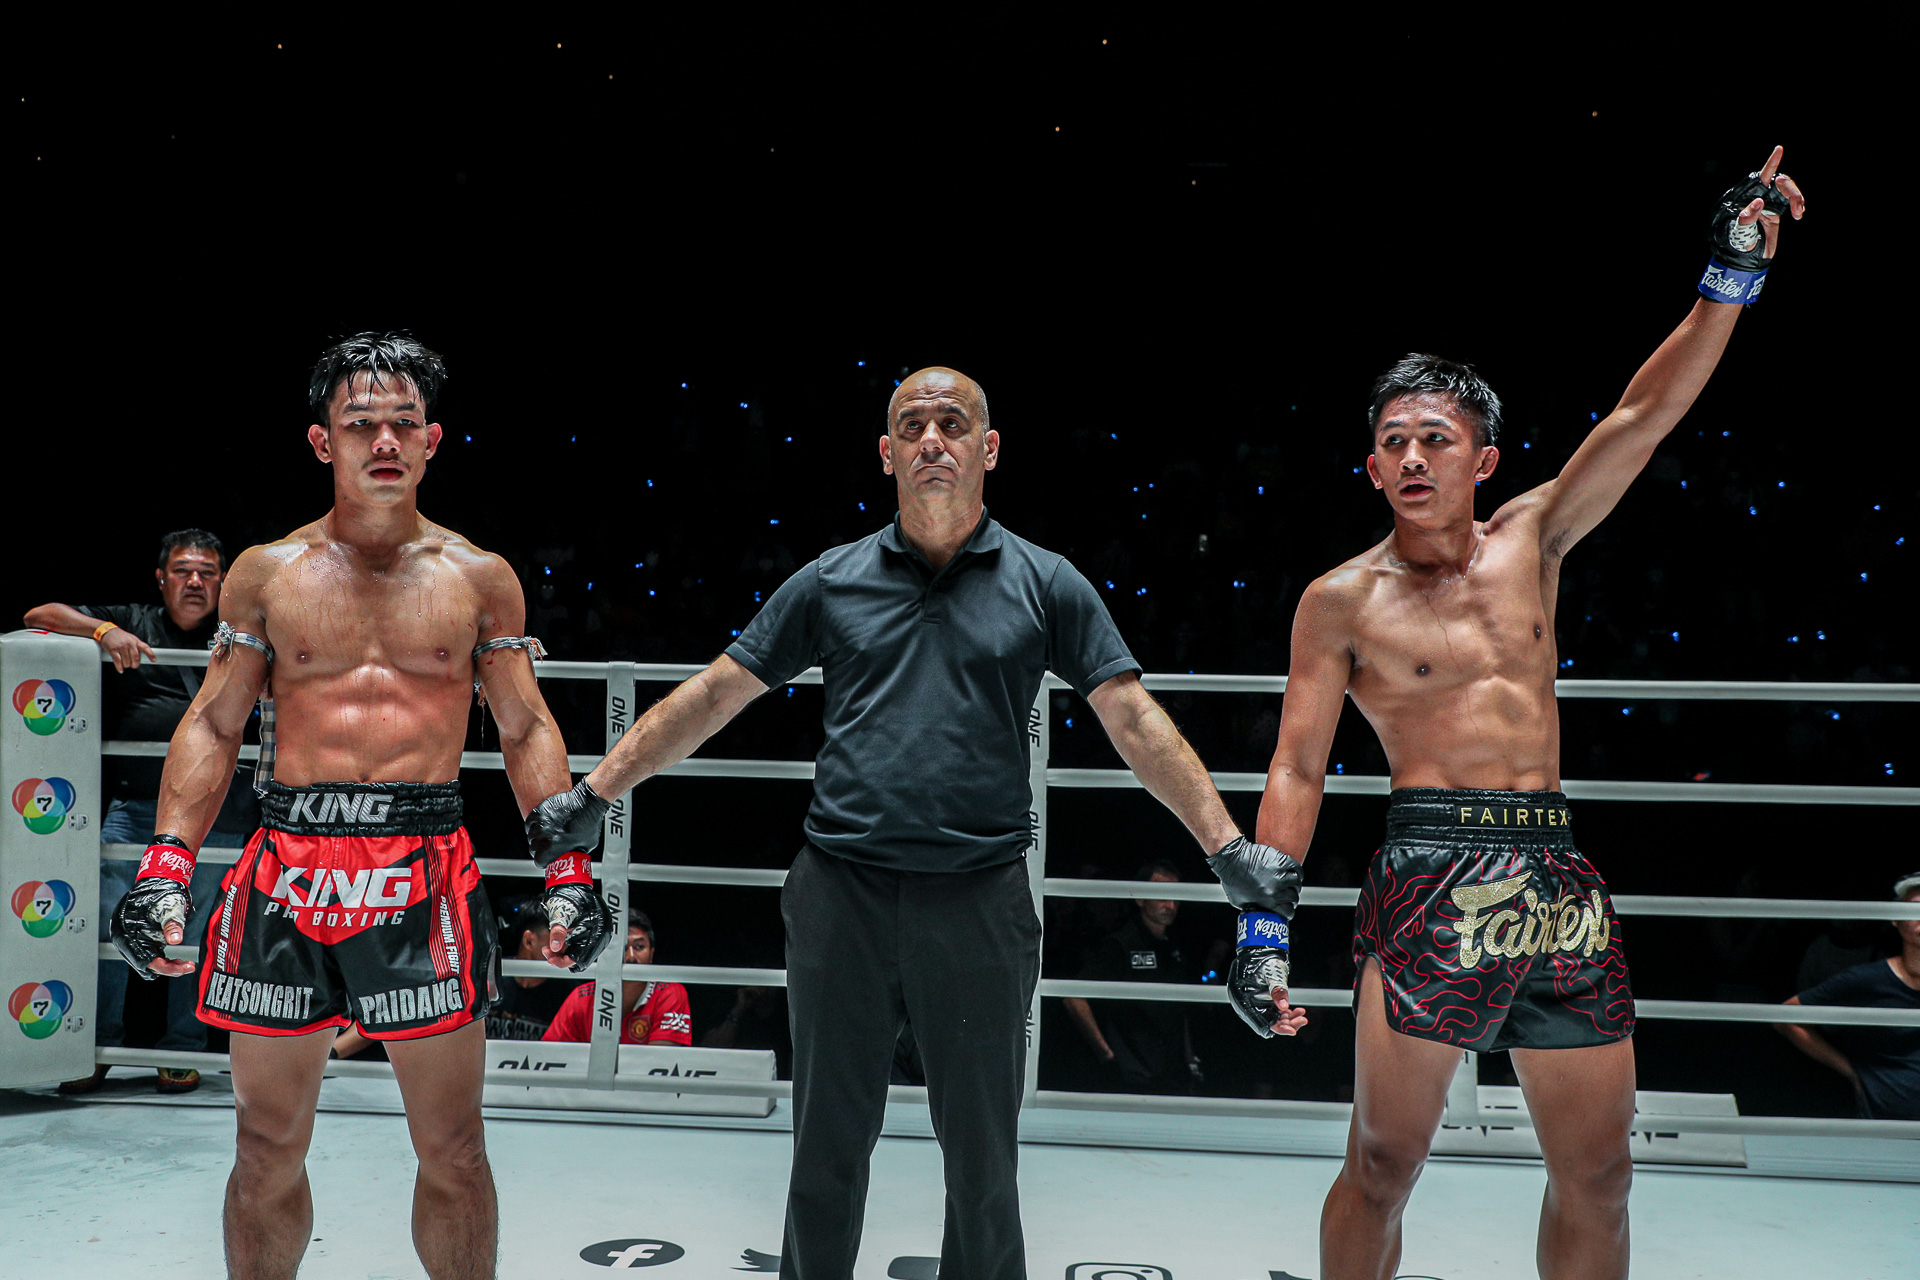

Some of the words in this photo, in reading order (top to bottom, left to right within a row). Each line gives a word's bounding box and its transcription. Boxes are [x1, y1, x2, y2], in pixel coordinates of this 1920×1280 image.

[1701, 264, 1746, 298] Fairtex
[37, 699, 52, 713] 7
[609, 696, 628, 738] ONE
[36, 797, 52, 811] 7
[288, 793, 394, 823] KING
[609, 799, 627, 839] ONE
[1460, 807, 1568, 826] FAIRTEX
[271, 865, 412, 908] KING
[36, 900, 51, 915] 7
[219, 884, 238, 941] PREMIUM
[312, 911, 405, 927] BOXING
[440, 895, 455, 944] PREMIUM
[1450, 870, 1610, 970] Fairtex
[216, 938, 228, 972] FIGHT
[446, 942, 460, 974] FIGHT
[1131, 953, 1154, 966] ONE
[33, 1001, 49, 1016] 7
[358, 978, 463, 1025] PAIDANG
[598, 988, 616, 1031] ONE
